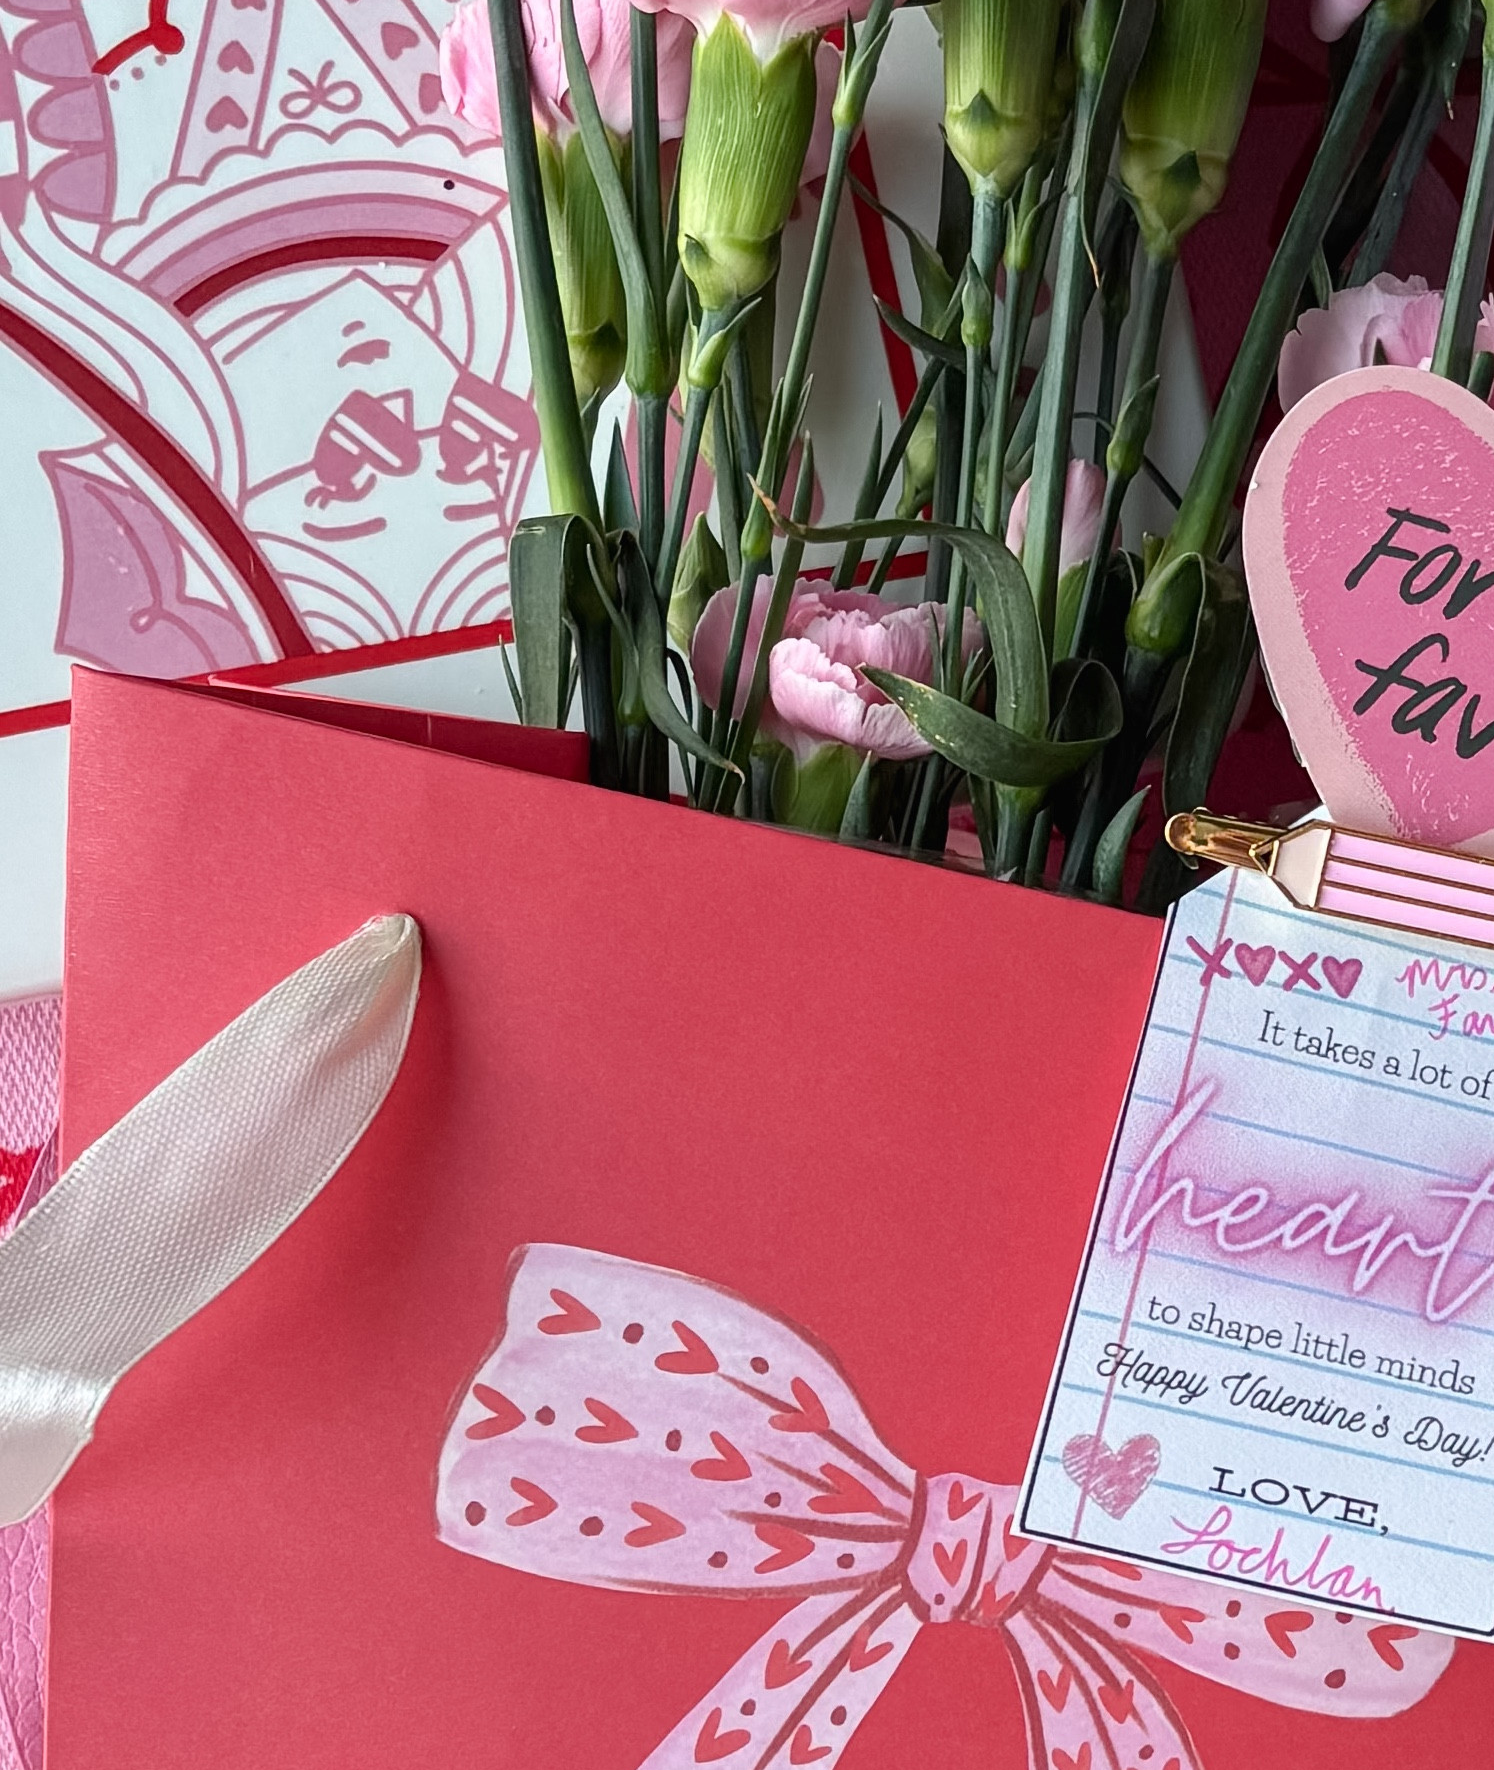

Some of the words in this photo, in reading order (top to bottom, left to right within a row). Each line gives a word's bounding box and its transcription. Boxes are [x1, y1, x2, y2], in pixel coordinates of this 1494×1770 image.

[1256, 1009, 1286, 1047] It
[1292, 1026, 1376, 1070] takes
[1382, 1056, 1402, 1078] a
[1409, 1048, 1453, 1090] lot
[1096, 1341, 1209, 1405] Happy
[1221, 1371, 1391, 1439] Valentine's
[1147, 1296, 1181, 1326] to
[1187, 1302, 1283, 1352] shape
[1289, 1322, 1367, 1370] little
[1376, 1354, 1477, 1396] minds
[1208, 1465, 1391, 1536] LOVE,
